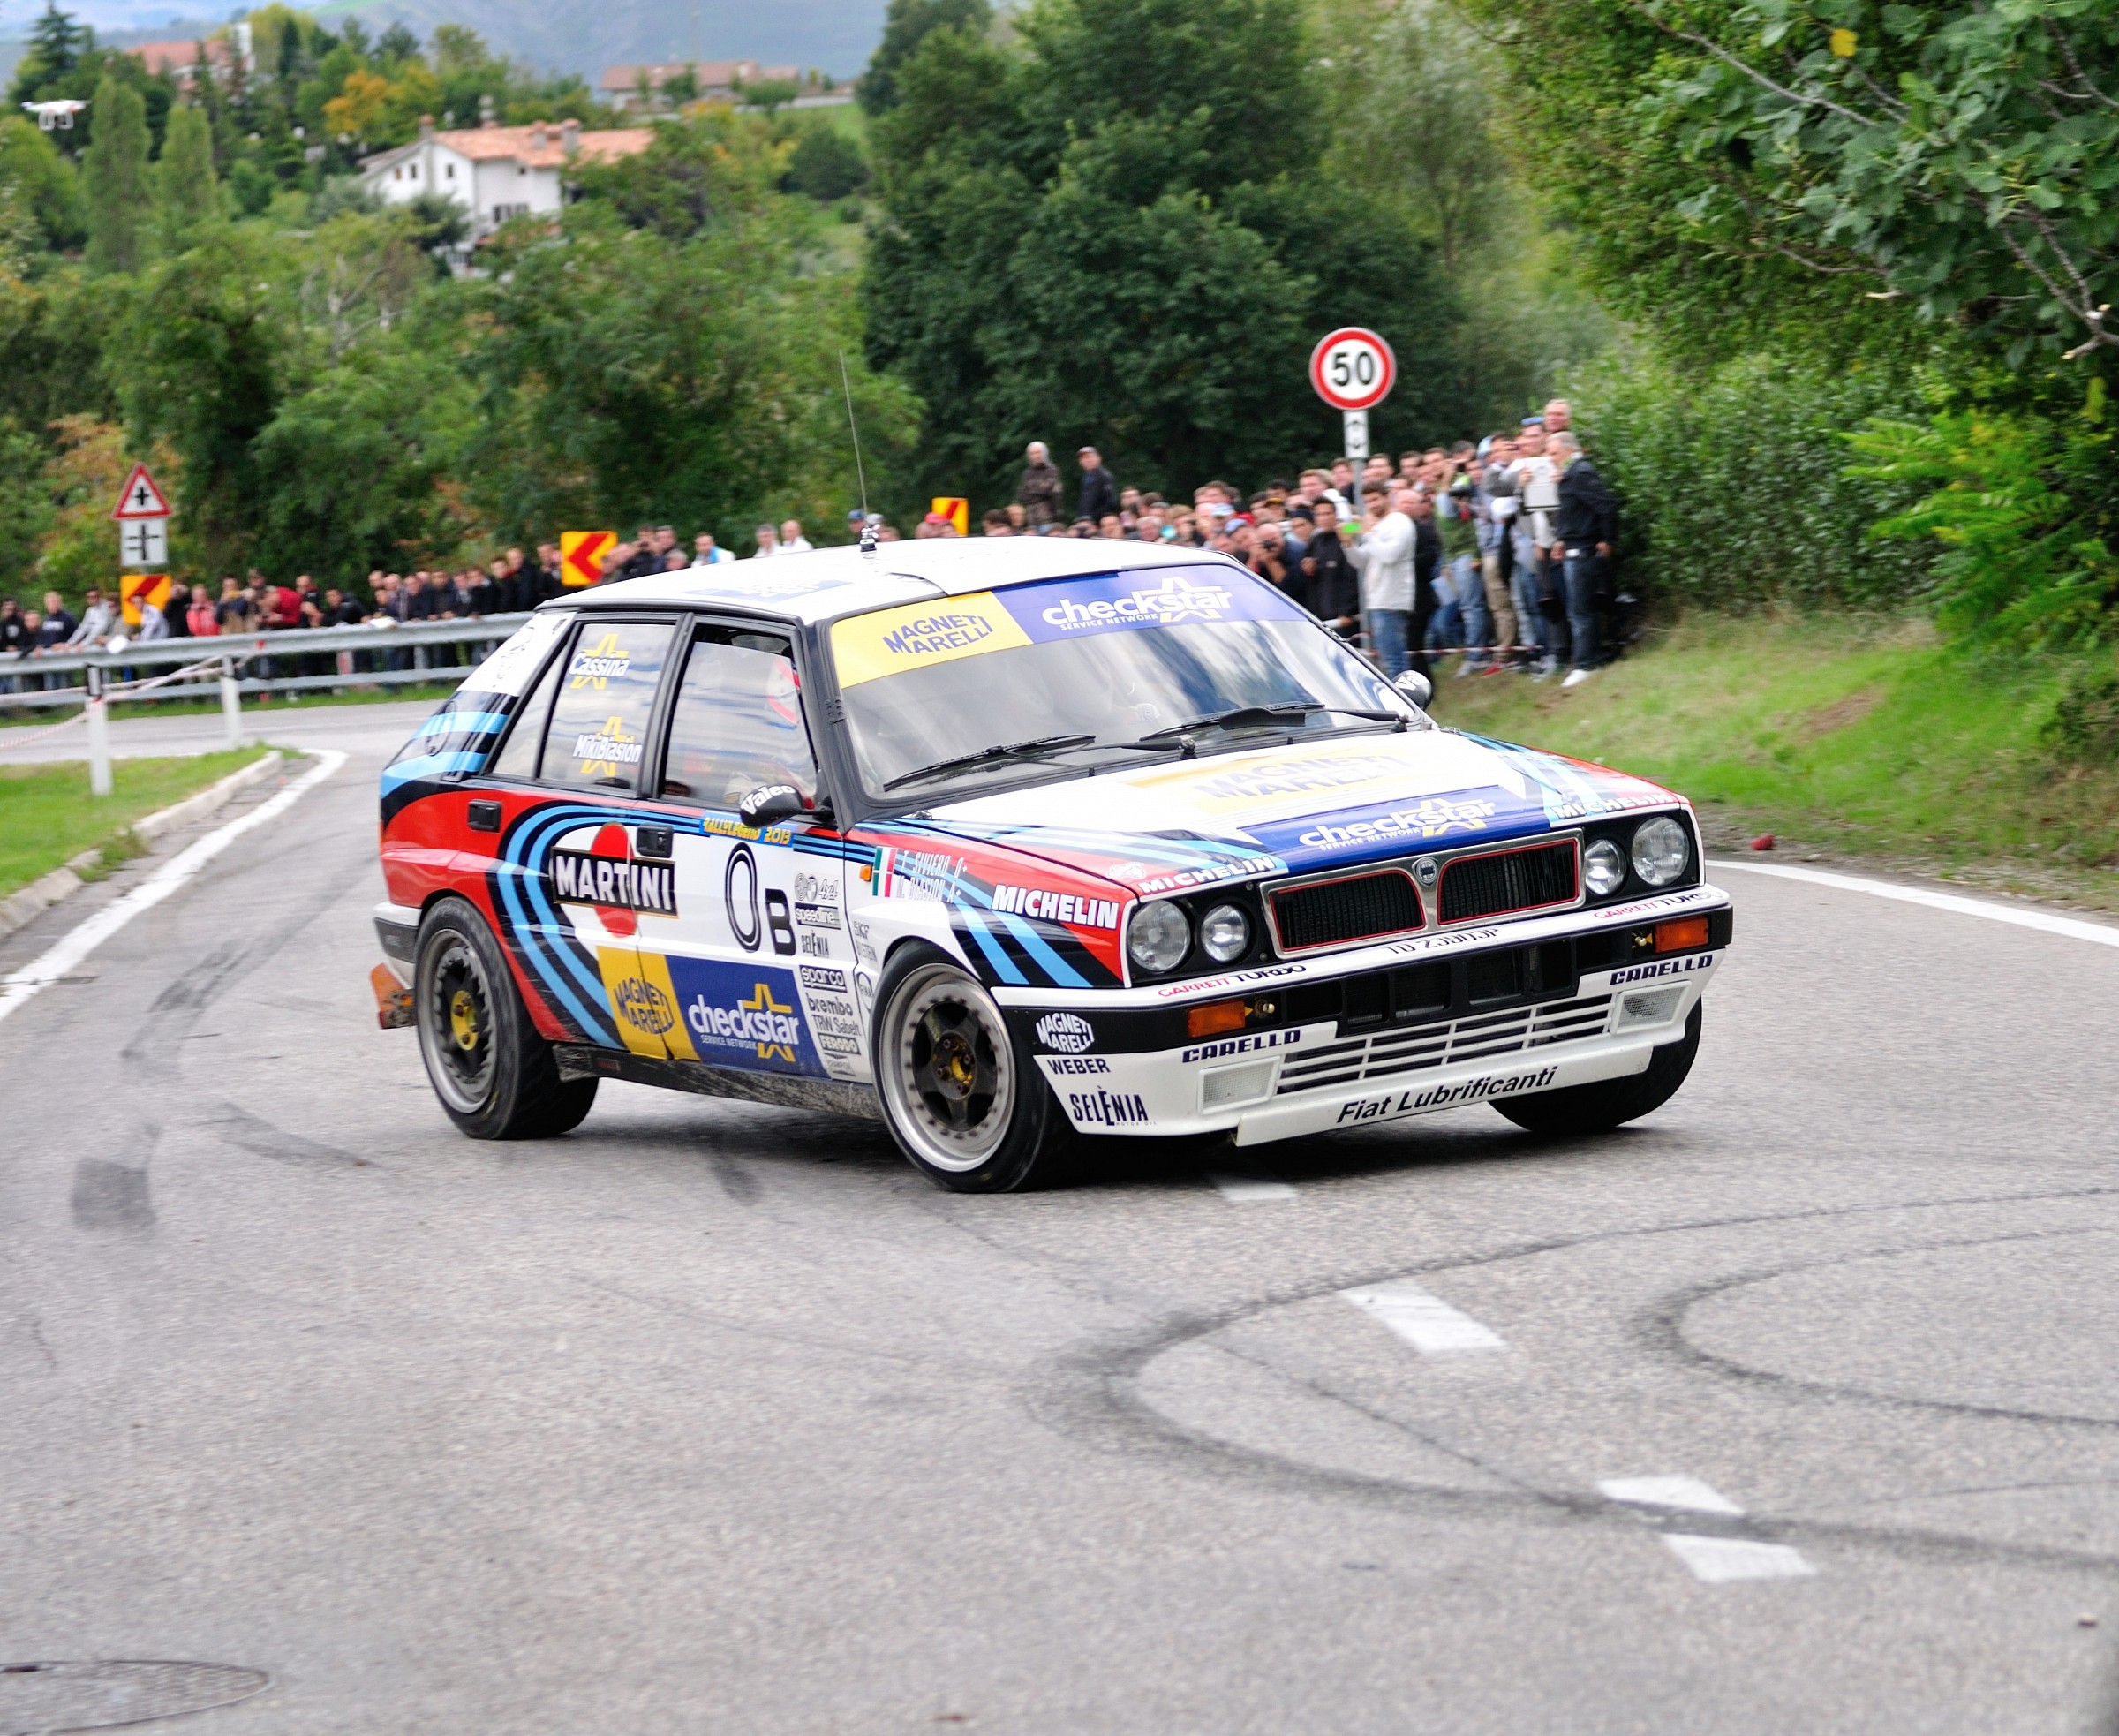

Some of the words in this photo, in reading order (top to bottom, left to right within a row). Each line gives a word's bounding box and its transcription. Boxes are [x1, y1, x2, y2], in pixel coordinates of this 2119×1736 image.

[1332, 351, 1375, 387] 50
[1042, 589, 1233, 627] checkstar
[1060, 619, 1102, 631] SERVICE
[1106, 613, 1159, 624] NETWORK
[883, 614, 989, 646] MAGNETI
[885, 622, 994, 654] MARELLI
[569, 652, 630, 677] Cassina
[572, 734, 643, 763] MikiBiasion
[1195, 755, 1413, 788] MAGNETI
[740, 784, 796, 815] Valeo
[1551, 793, 1676, 819] MICHELIN
[763, 826, 792, 845] 2013
[1298, 798, 1497, 847] checkstar
[1319, 837, 1363, 851] SERVICE
[1367, 826, 1421, 843] NETWORK
[554, 854, 672, 910] MARTINI
[1137, 856, 1277, 894] MICHELIN
[991, 884, 1120, 929] MICHELIN
[1593, 902, 1659, 919] GARRETT
[801, 966, 845, 988] sparco
[1157, 977, 1232, 998] GARRETT
[1233, 964, 1308, 983] TURBO
[1609, 954, 1714, 986] CARELLO
[614, 977, 673, 1009] MAGNETI
[804, 992, 854, 1017] brembo
[615, 996, 675, 1035] MARELLI
[687, 994, 800, 1045] checkstar
[811, 1014, 834, 1033] TRW
[1036, 1012, 1093, 1035] MAGNETI
[700, 1035, 727, 1047] SERVICE
[726, 1038, 758, 1050] NETWORK
[820, 1034, 858, 1053] FERODO
[1037, 1030, 1095, 1053] MARELLI
[1181, 1029, 1301, 1063] CARELLO
[1046, 1058, 1112, 1075] WEBER
[1068, 1084, 1149, 1127] SELÈNIA
[1336, 1095, 1392, 1124] Fiat
[1396, 1065, 1559, 1113] Lubrificanti
